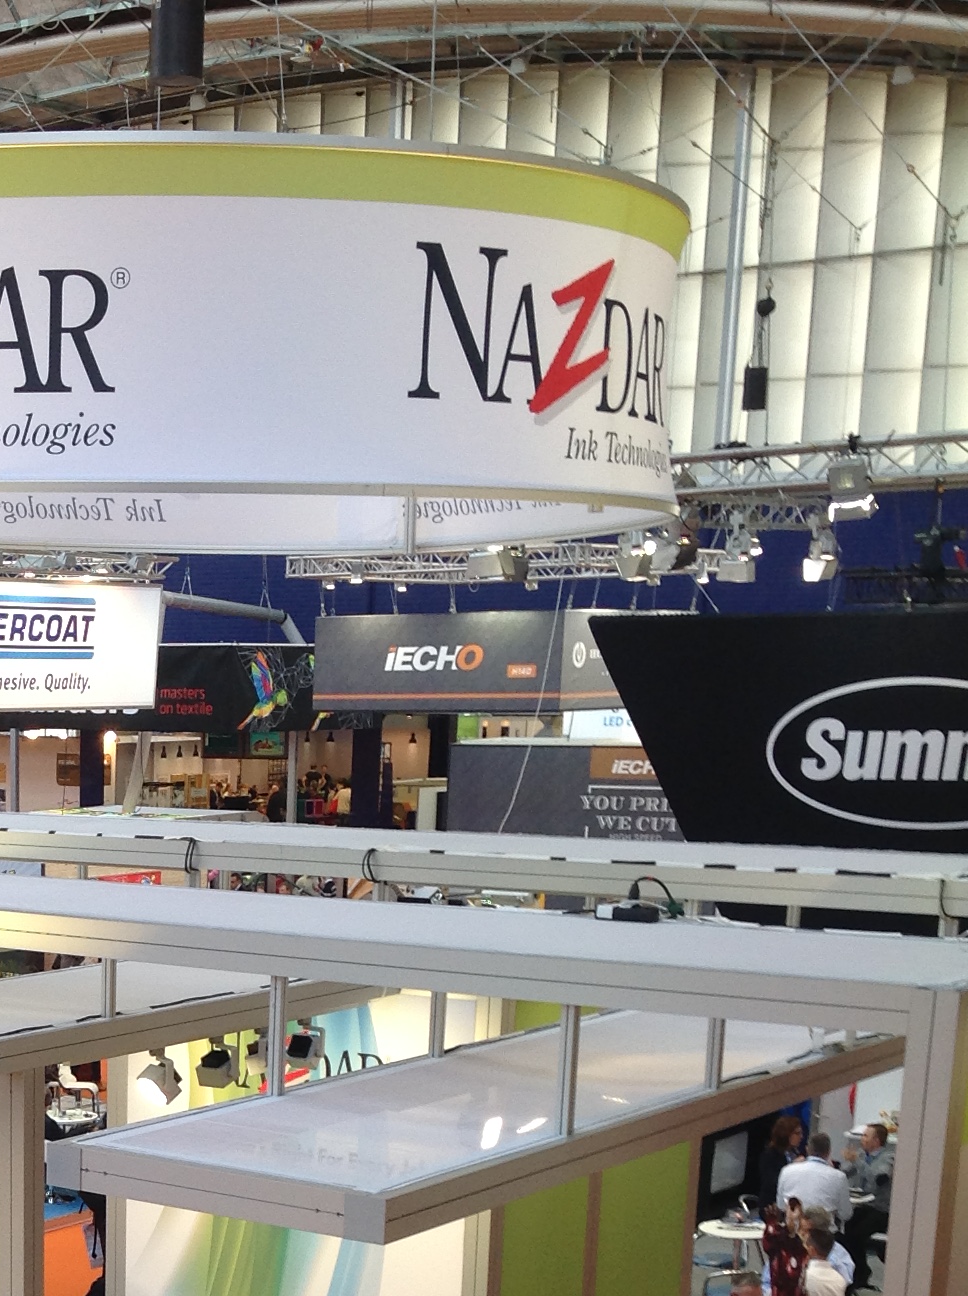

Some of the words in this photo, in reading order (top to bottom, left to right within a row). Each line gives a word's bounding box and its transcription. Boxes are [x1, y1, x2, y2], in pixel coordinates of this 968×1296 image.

[565, 427, 598, 461] Ink
[384, 642, 484, 672] iECHO
[45, 673, 91, 694] Quality.
[160, 687, 205, 700] masters
[160, 704, 173, 715] on
[176, 702, 213, 716] textile
[580, 795, 626, 811] YOU
[630, 797, 673, 812] PRI
[597, 815, 632, 831] WE
[636, 816, 678, 832] CUT
